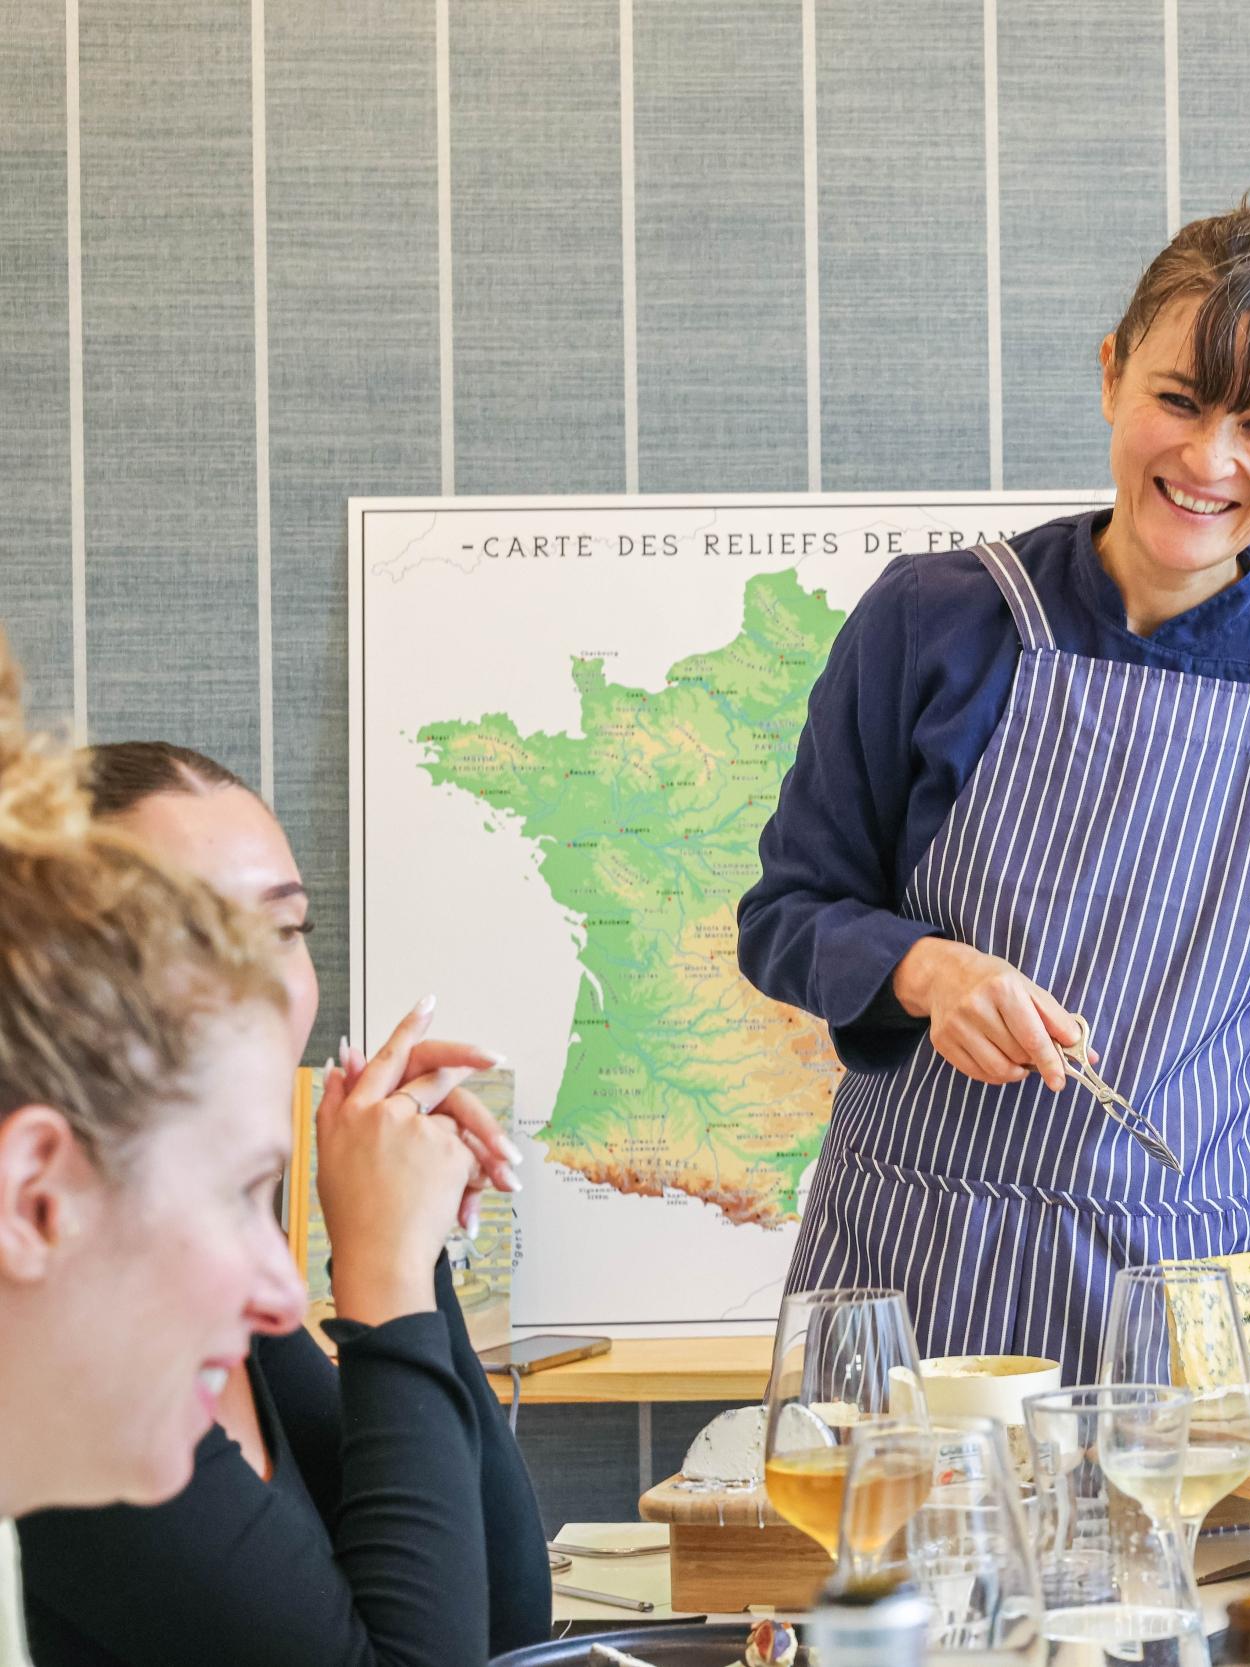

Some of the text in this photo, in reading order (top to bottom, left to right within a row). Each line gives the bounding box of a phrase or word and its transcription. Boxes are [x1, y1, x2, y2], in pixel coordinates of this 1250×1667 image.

[618, 534, 679, 557] DES
[704, 532, 839, 556] RELIEFS
[863, 531, 903, 555] DE
